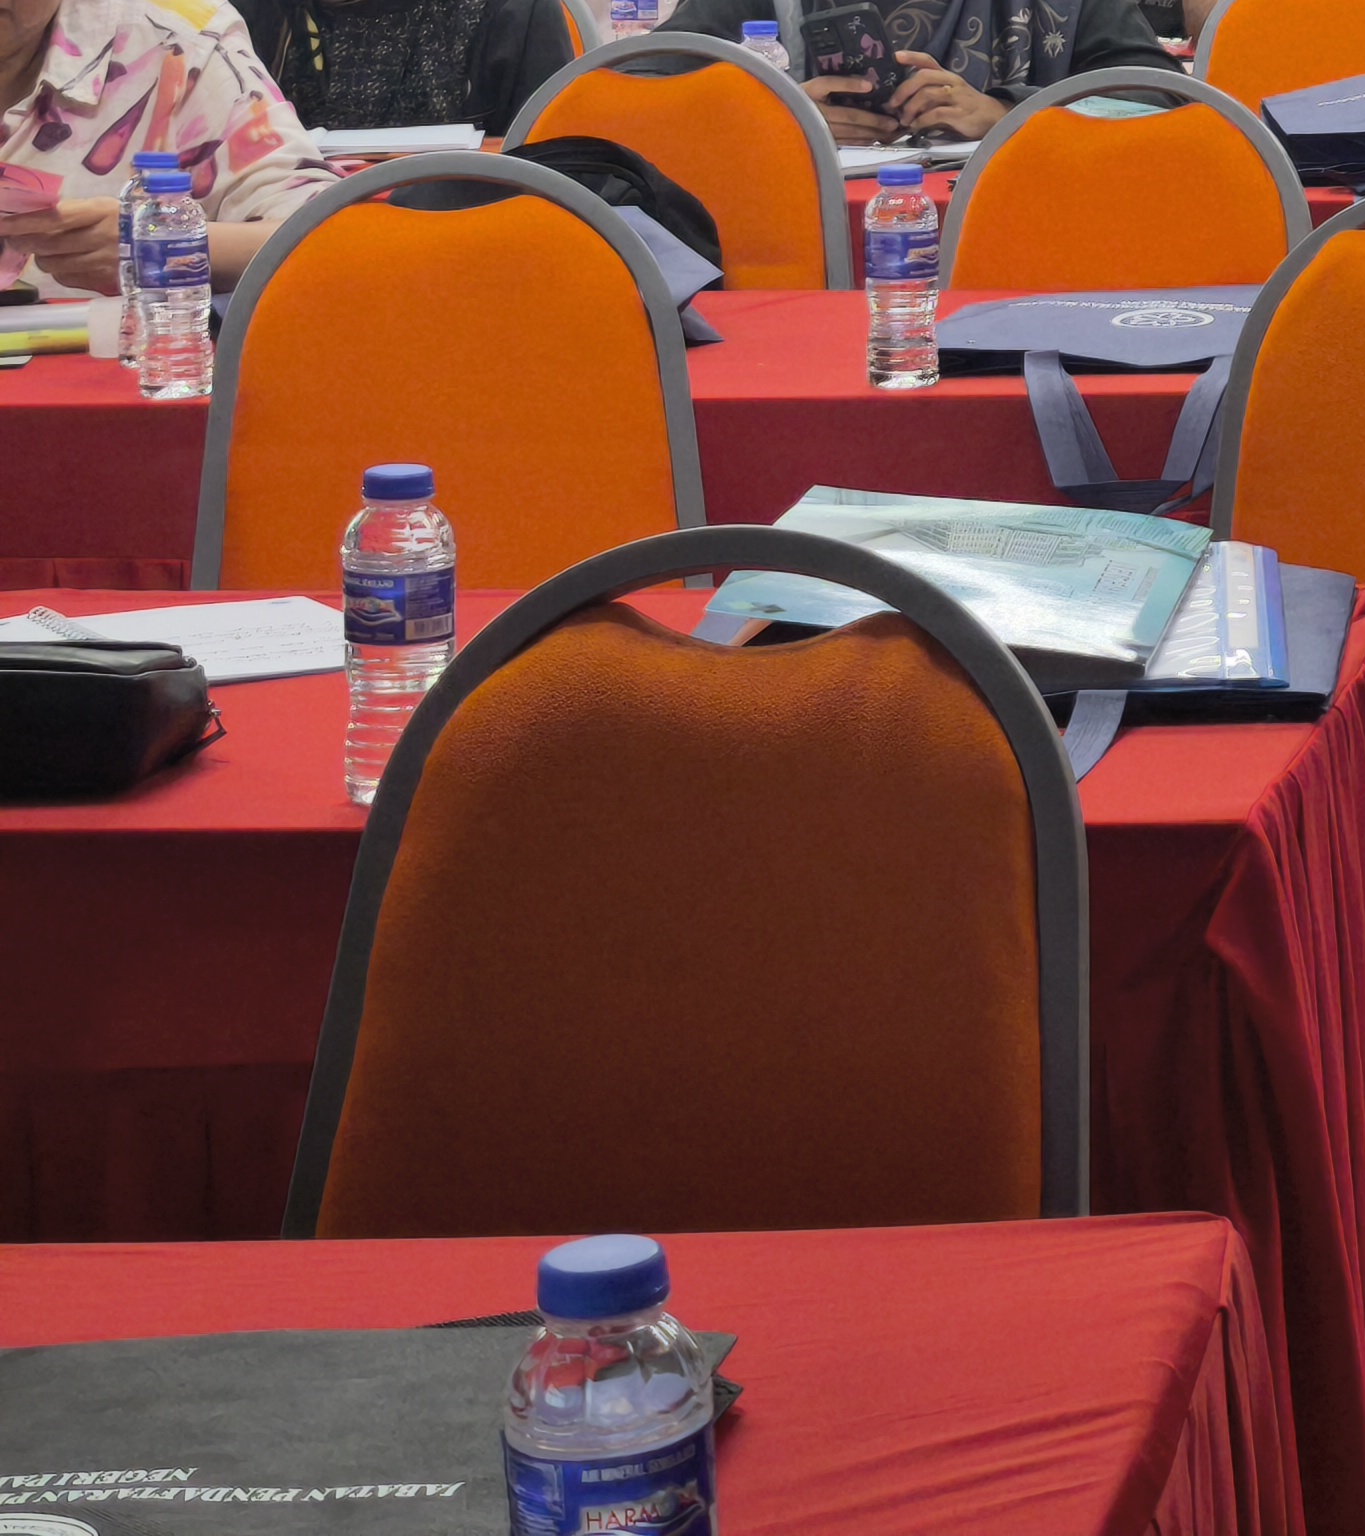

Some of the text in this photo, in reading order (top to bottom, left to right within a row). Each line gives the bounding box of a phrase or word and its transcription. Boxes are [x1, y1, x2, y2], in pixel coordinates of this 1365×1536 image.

[53, 1467, 198, 1487] NEGERI
[32, 1485, 303, 1504] PENDAFTARAN
[301, 1481, 466, 1502] JABATAN
